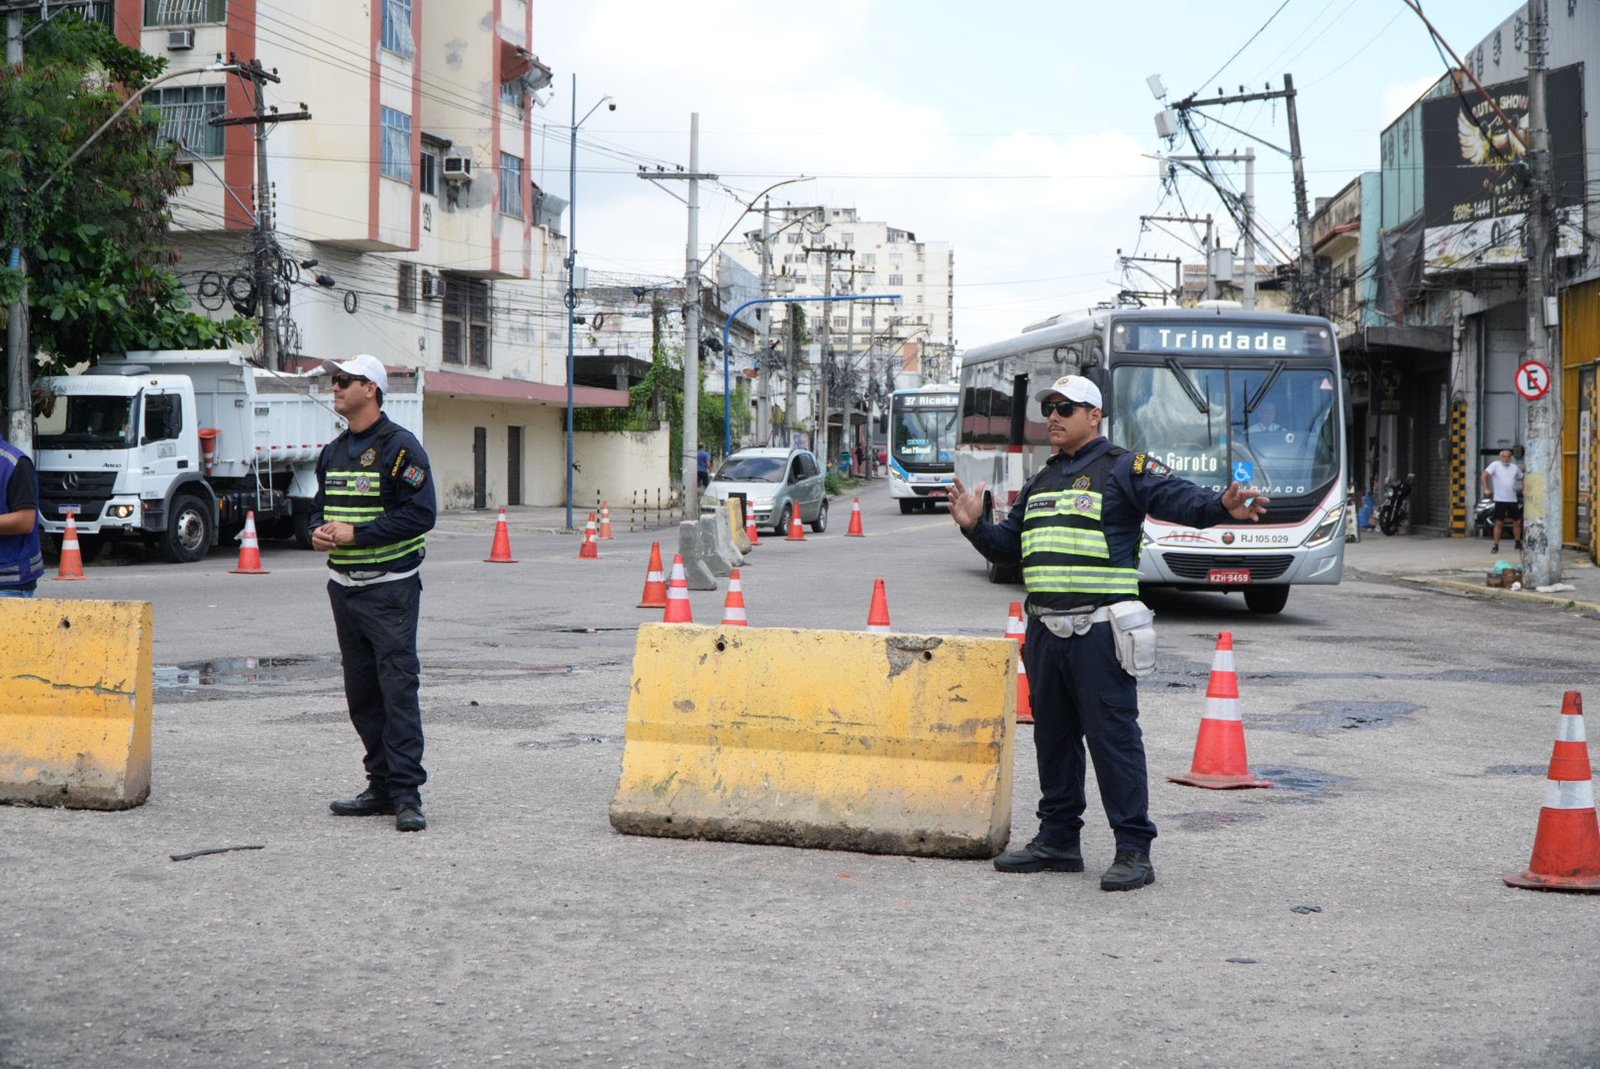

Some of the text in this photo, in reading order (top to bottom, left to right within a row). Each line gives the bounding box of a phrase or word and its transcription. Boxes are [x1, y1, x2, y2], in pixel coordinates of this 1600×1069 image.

[1471, 94, 1530, 118] AUTO SHOW
[1159, 329, 1286, 350] Trindade
[1527, 369, 1538, 390] E
[1132, 452, 1147, 474] GMSG
[1167, 452, 1217, 472] Garoto
[1240, 534, 1289, 543] RJ 105 029
